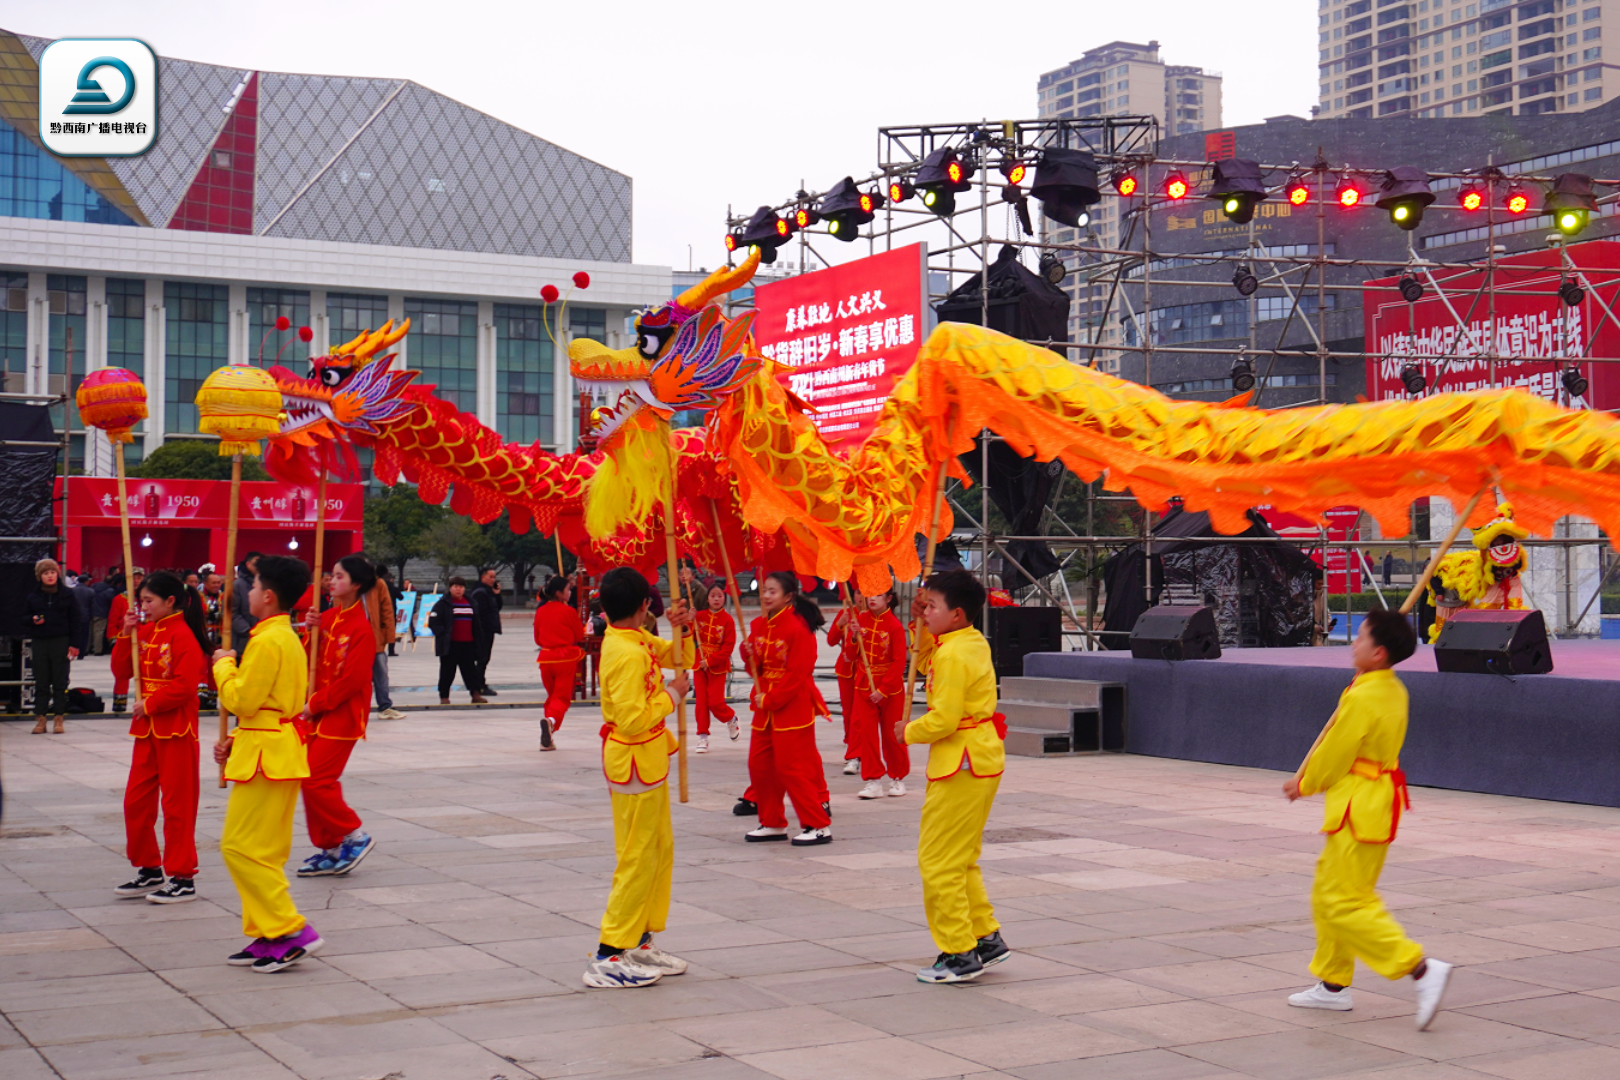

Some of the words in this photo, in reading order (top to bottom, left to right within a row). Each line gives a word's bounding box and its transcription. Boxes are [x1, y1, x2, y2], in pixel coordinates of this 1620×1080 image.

[1204, 223, 1273, 235] INTERNATINAL
[166, 495, 200, 507] 1950
[312, 498, 343, 511] 150
